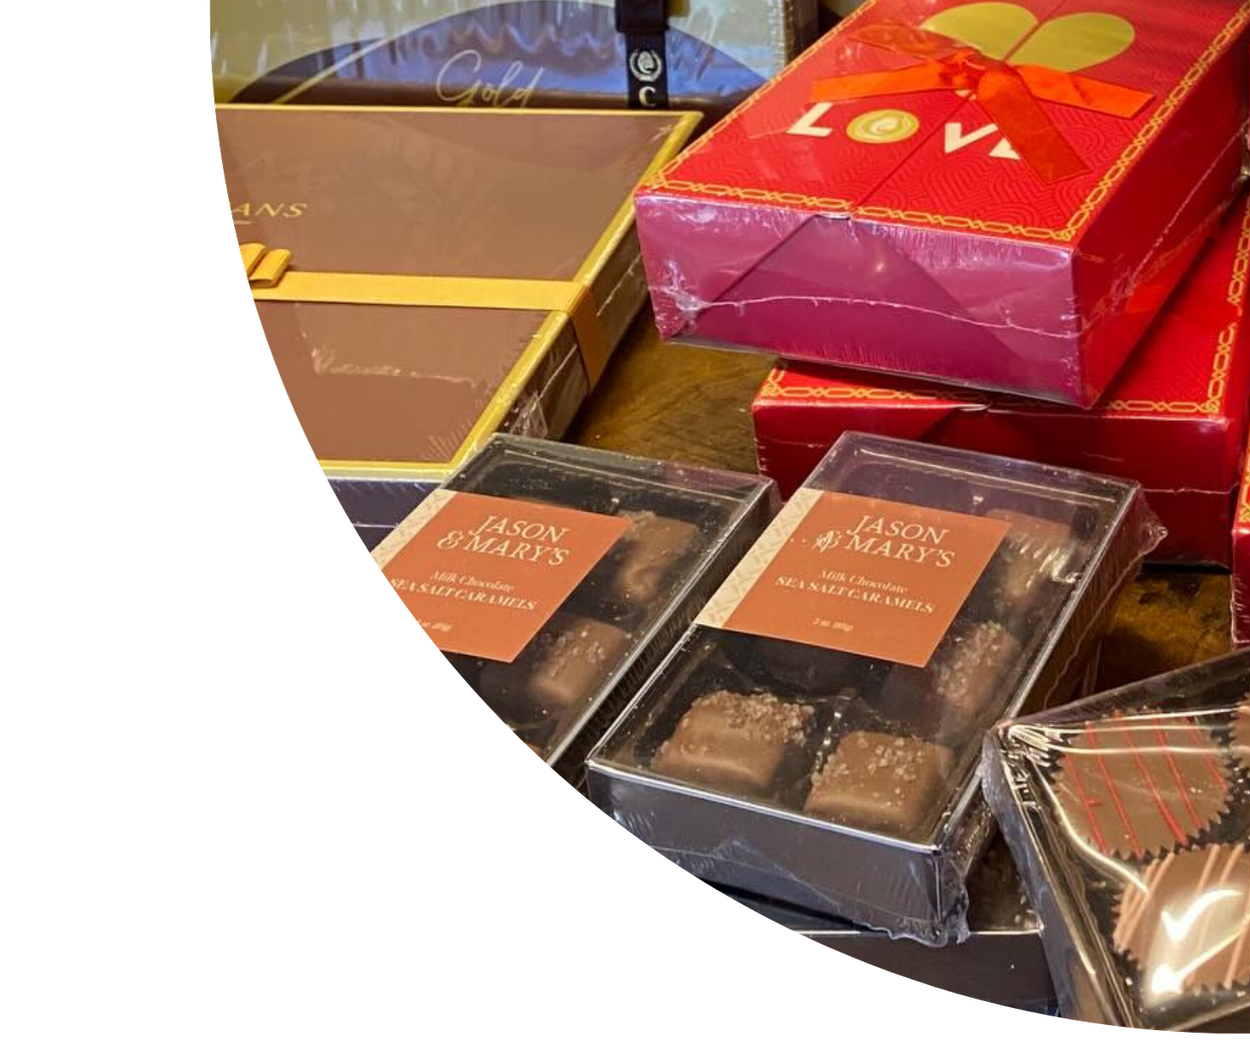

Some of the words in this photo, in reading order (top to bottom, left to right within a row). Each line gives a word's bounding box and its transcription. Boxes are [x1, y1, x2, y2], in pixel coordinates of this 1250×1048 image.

[436, 49, 543, 108] Gold
[469, 515, 571, 543] JASON
[847, 515, 949, 544] JASON
[437, 530, 465, 550] &
[464, 535, 570, 566] MARY'S
[812, 530, 843, 552] &
[846, 534, 956, 568] MARY'S
[389, 577, 415, 592] SEA
[416, 583, 456, 597] SALT
[454, 589, 536, 611] CARAMELS
[430, 570, 458, 583] Milk
[458, 575, 515, 592] Chocolate
[775, 576, 805, 590] SEA
[806, 581, 849, 596] SALT
[847, 590, 936, 614] CARAMELS
[818, 570, 847, 583] Milk
[849, 574, 909, 594] Chocolate
